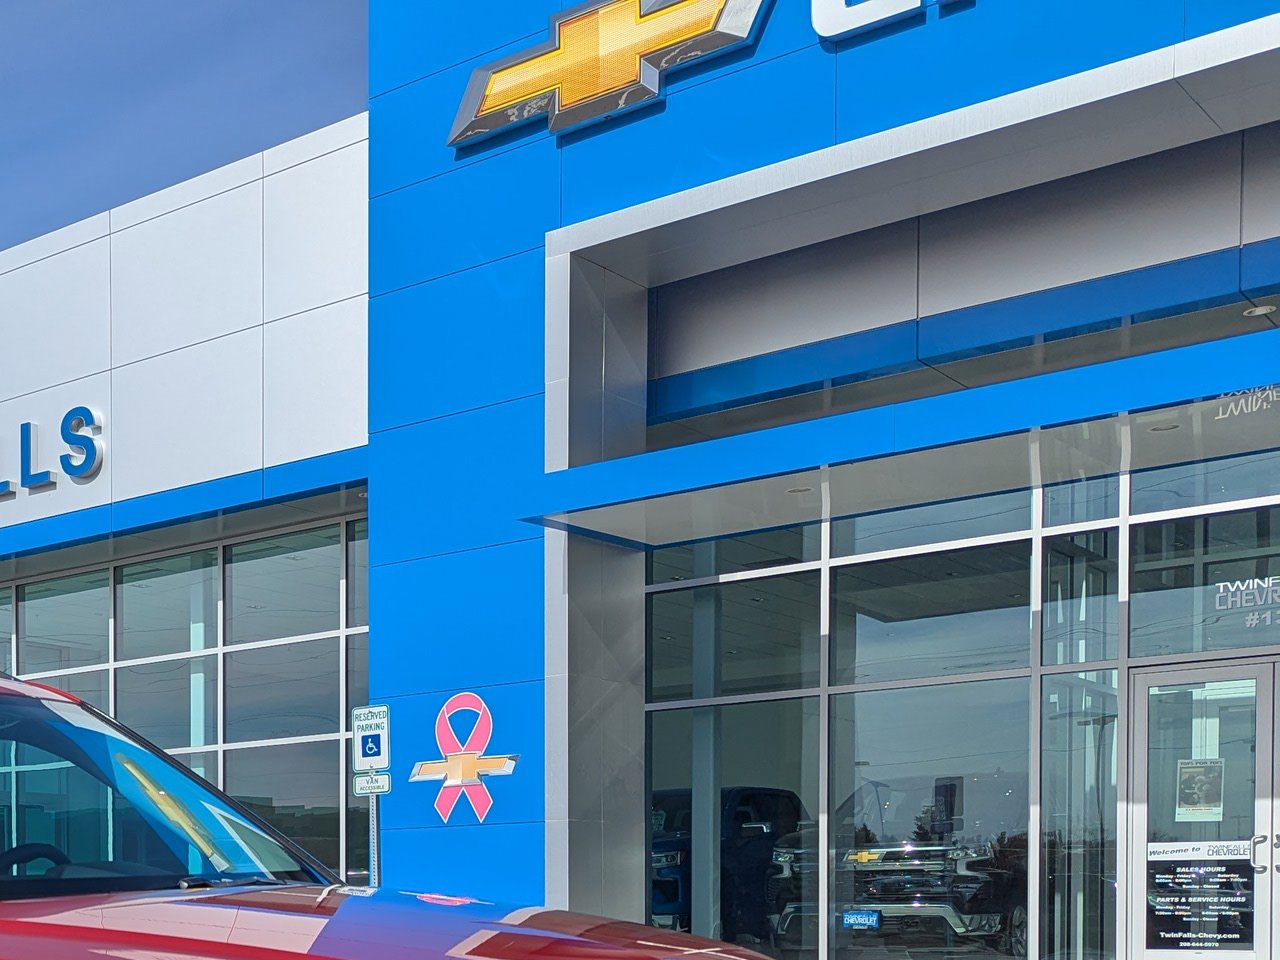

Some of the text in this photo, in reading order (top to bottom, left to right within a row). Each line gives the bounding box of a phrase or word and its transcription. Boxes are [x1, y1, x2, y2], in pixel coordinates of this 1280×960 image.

[355, 711, 387, 722] RESERVED
[357, 722, 385, 733] PARKING
[1148, 847, 1189, 856] Welcome
